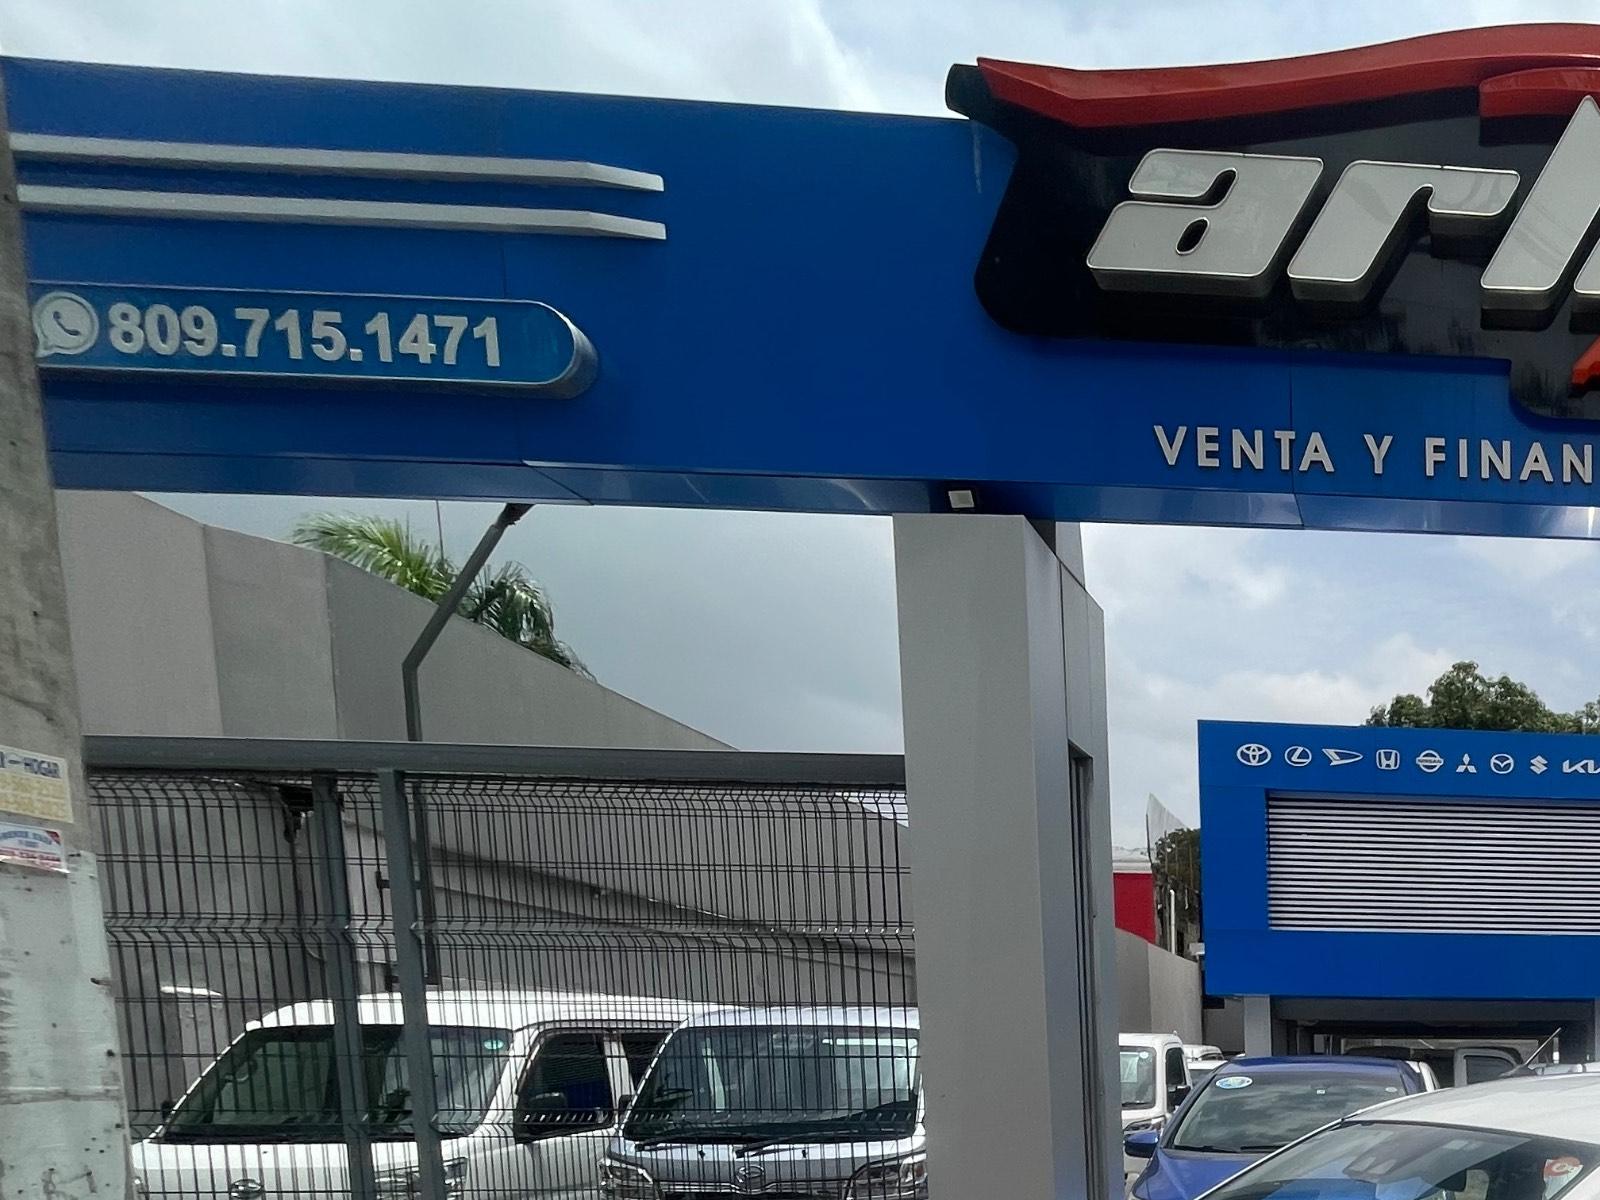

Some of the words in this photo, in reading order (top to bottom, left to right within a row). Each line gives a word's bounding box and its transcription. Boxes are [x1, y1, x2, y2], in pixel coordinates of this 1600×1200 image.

[108, 302, 501, 367] 809.715.1471
[1153, 424, 1336, 473] VENTA
[1364, 433, 1395, 476] Y
